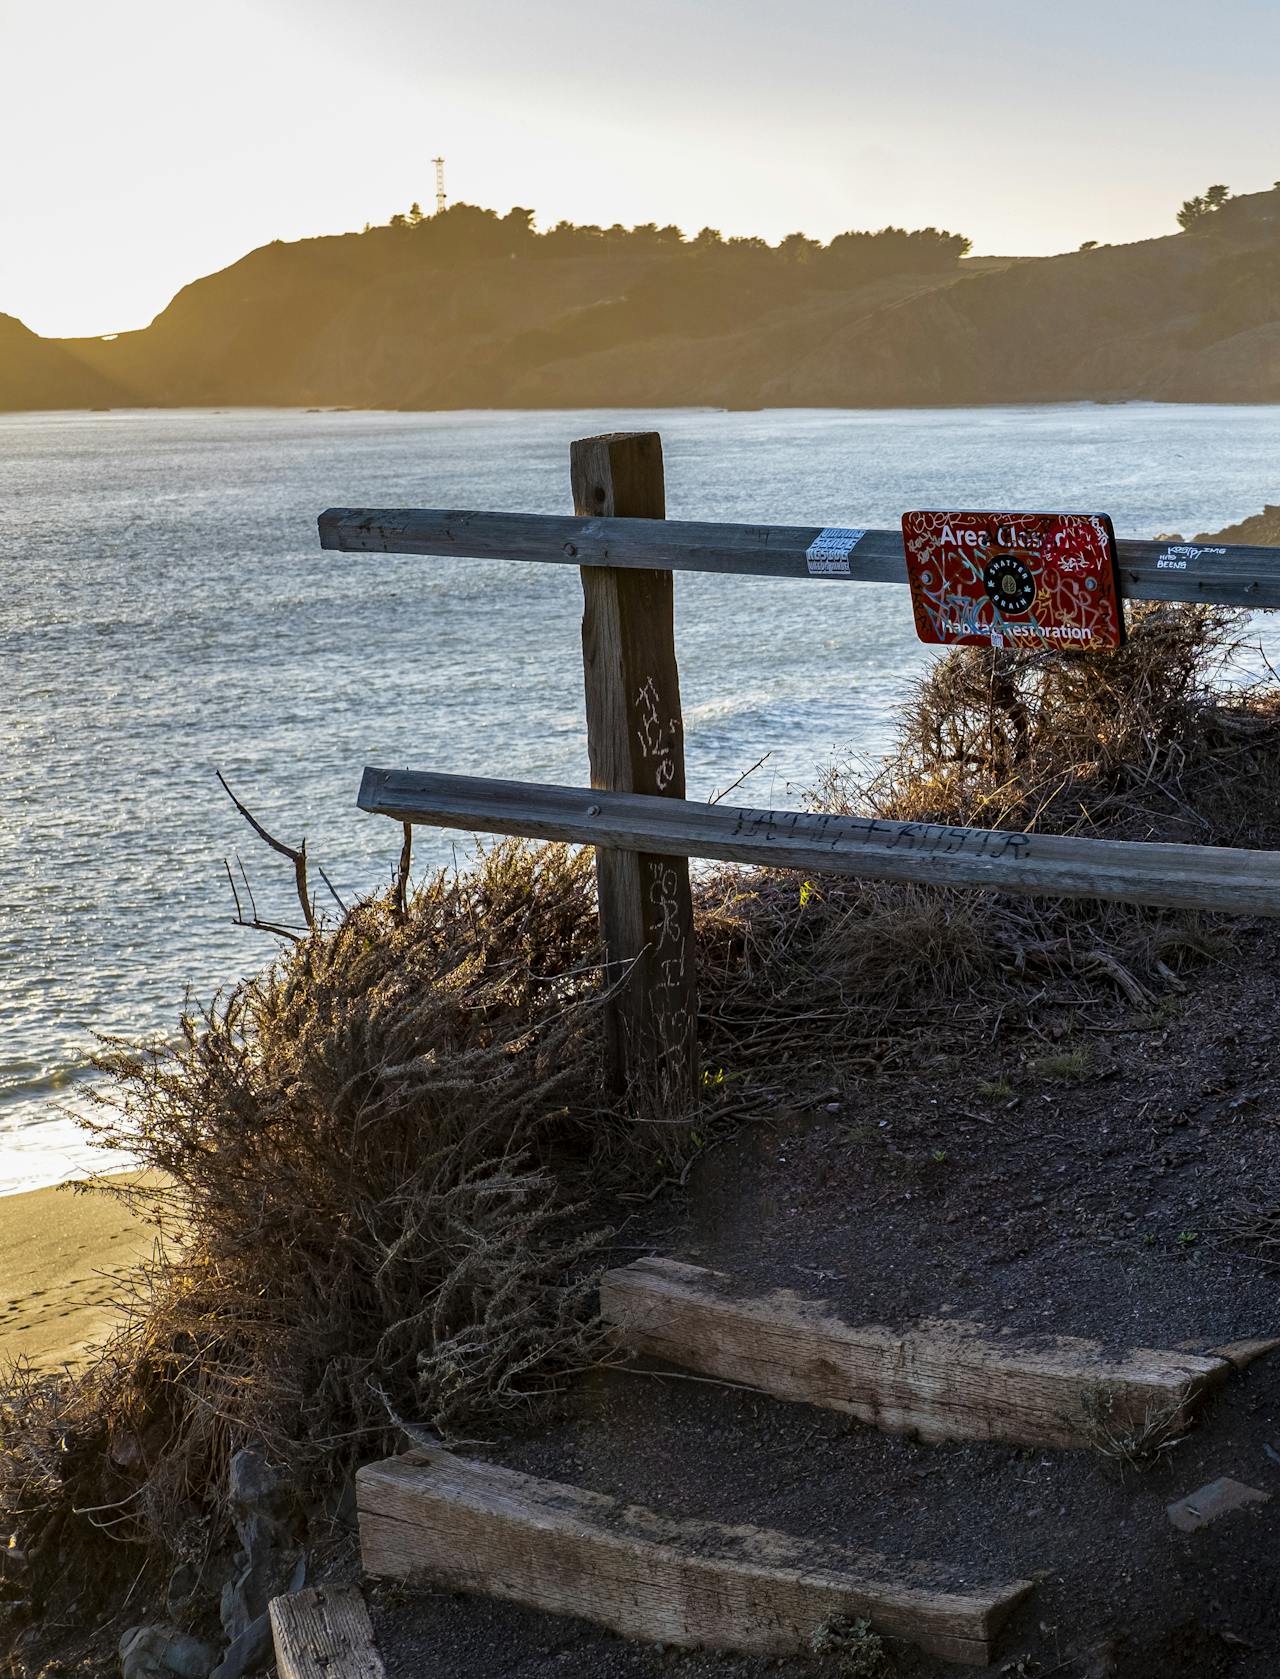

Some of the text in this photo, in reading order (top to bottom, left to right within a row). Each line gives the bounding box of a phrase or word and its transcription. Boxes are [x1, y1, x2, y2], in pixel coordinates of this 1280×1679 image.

[940, 525, 1070, 548] Area Clos
[989, 559, 1028, 580] SHATTER
[941, 619, 997, 636] Habta
